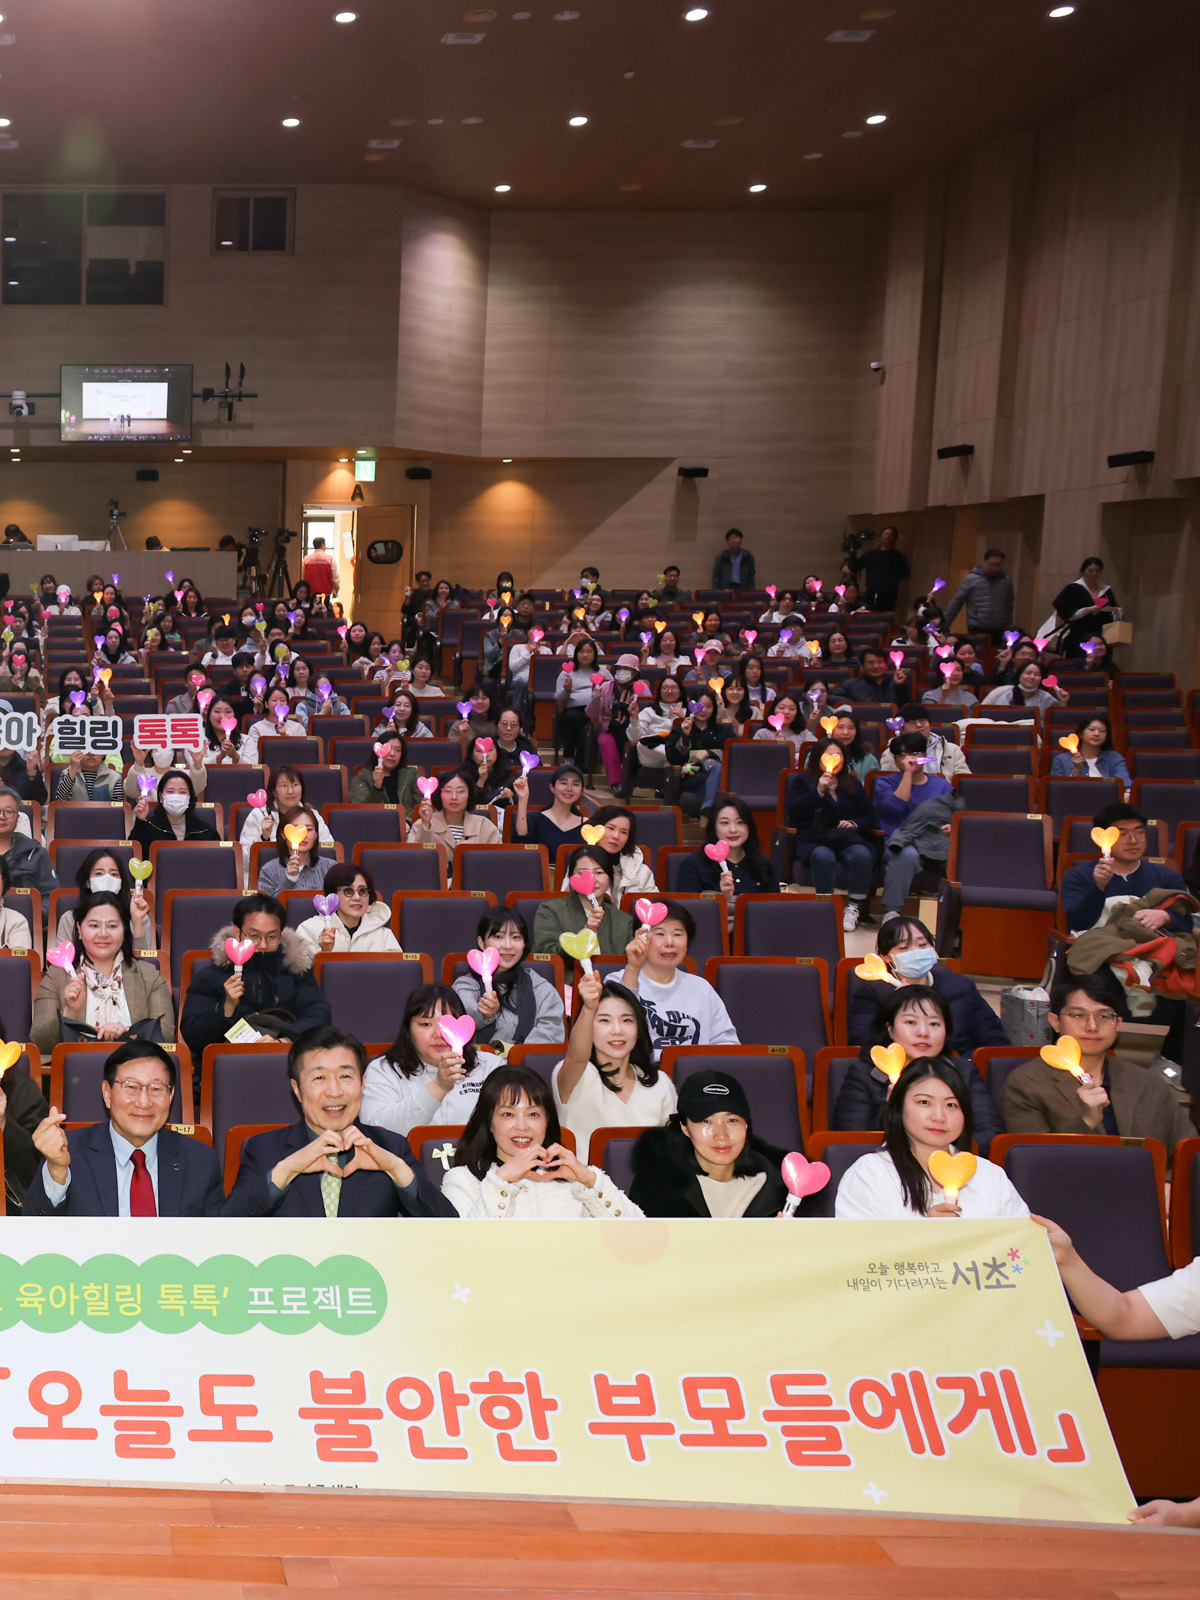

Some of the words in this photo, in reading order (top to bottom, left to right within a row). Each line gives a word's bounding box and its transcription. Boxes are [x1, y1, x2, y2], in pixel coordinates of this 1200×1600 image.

[351, 484, 365, 501] A
[57, 716, 119, 751] 힐링
[137, 716, 201, 748] 톡톡
[846, 1278, 882, 1292] 내일이
[887, 1277, 949, 1291] 기다려지는
[866, 1262, 890, 1276] 오늘
[893, 1262, 944, 1276] 행복하고
[951, 1257, 1017, 1291] 서초
[15, 1282, 143, 1316] 육아힐링
[246, 1285, 378, 1318] 프로젝트
[298, 1369, 559, 1463] 불안한
[587, 1369, 1086, 1467] 부모들에게」
